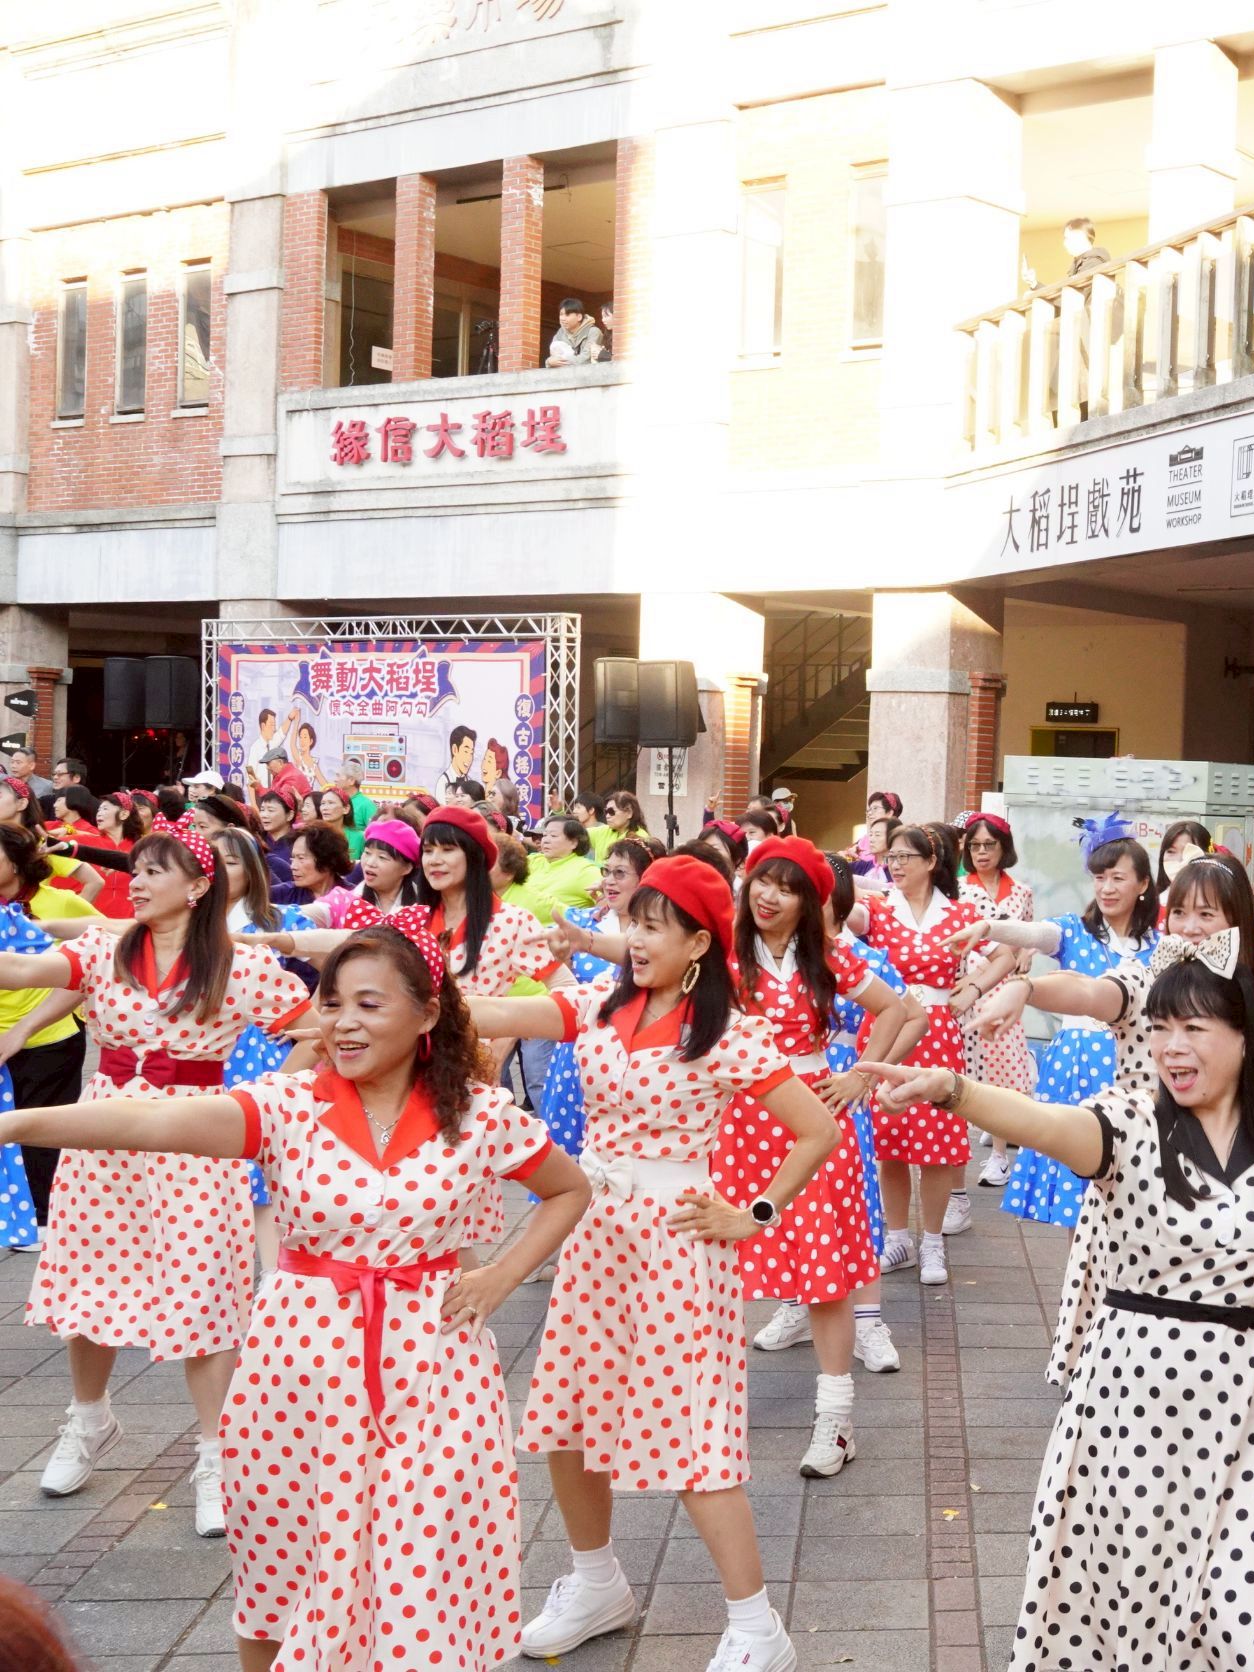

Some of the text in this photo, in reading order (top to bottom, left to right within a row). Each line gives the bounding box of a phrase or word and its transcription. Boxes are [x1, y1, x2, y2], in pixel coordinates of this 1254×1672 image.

[329, 405, 568, 466] 緣信大稻埕
[1168, 464, 1203, 482] THEATER
[1000, 466, 1145, 557] 大稻埕戲苑
[1167, 489, 1202, 508] MUSEUM
[1166, 513, 1202, 529] WORKSHOP
[310, 659, 438, 695] 舞動大稻埕
